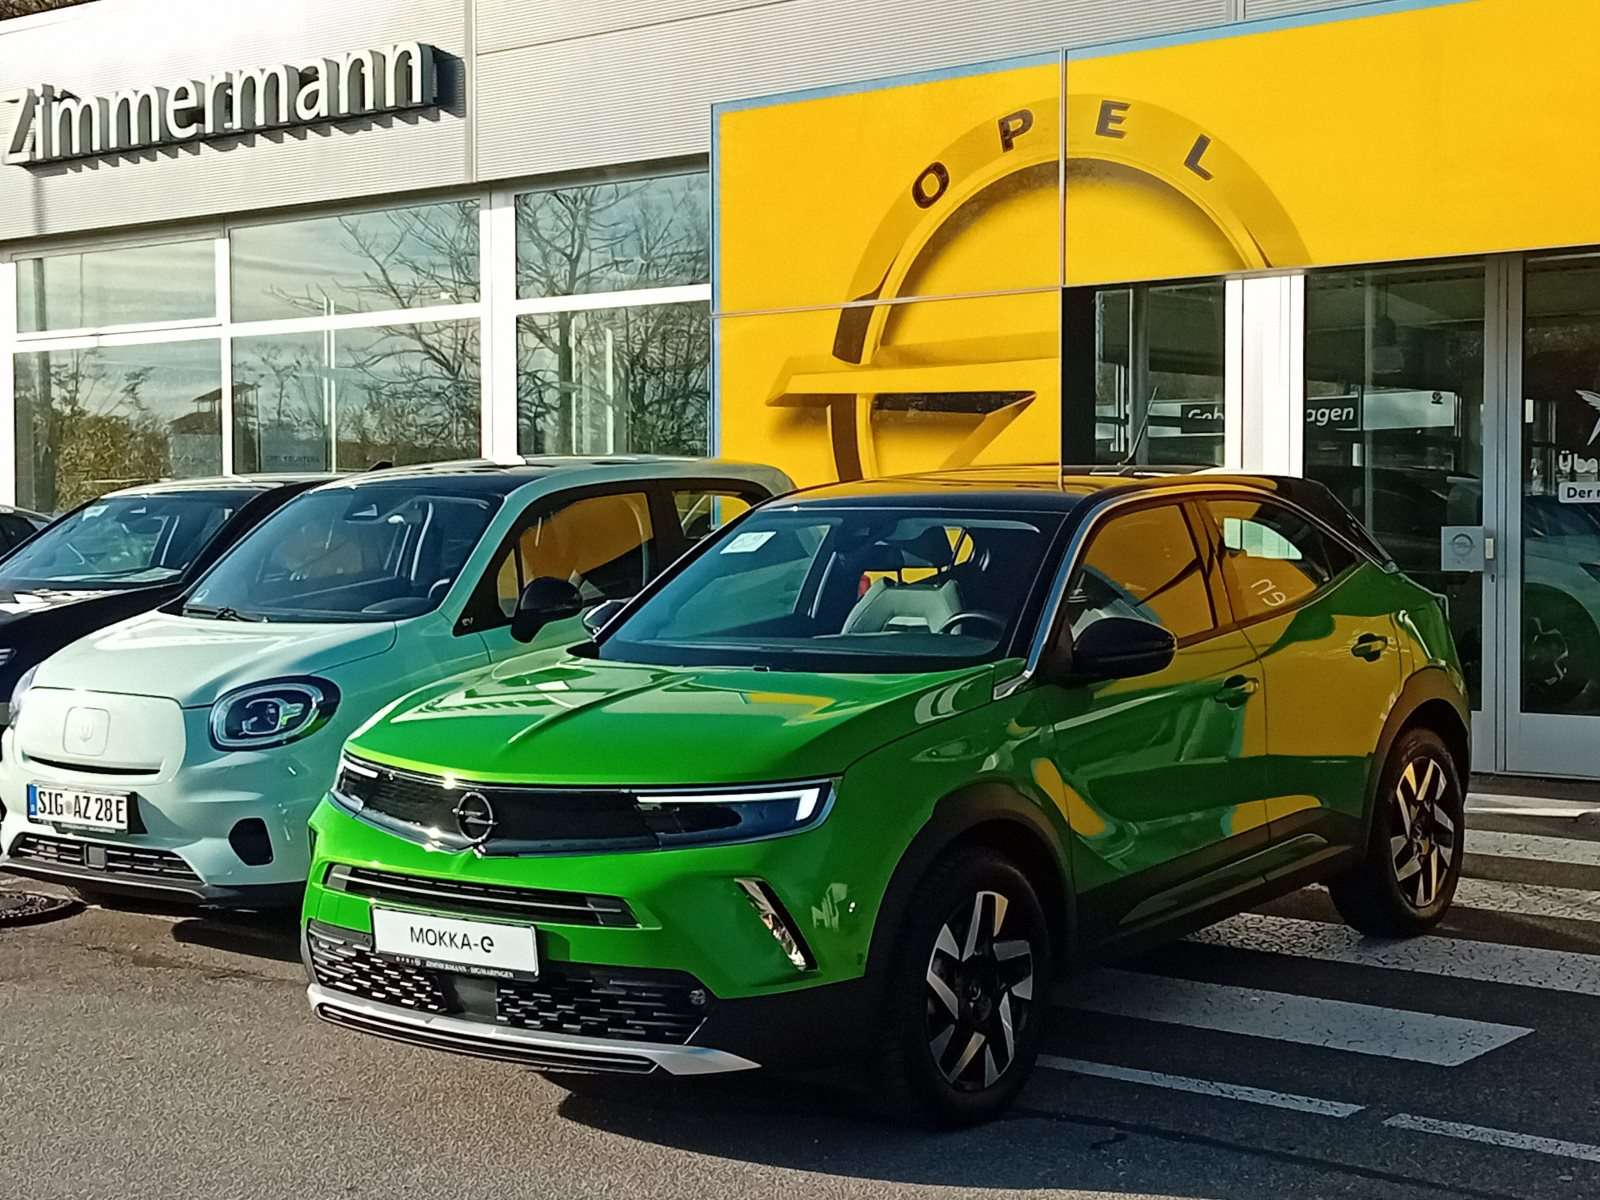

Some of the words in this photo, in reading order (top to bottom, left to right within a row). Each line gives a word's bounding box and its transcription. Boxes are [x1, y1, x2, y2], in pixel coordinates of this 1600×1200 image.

[4, 41, 433, 166] Zimmermann
[912, 99, 1214, 209] OPEL
[1566, 486, 1593, 499] Der
[38, 790, 64, 816] SIG
[409, 926, 495, 953] MOKKA-e
